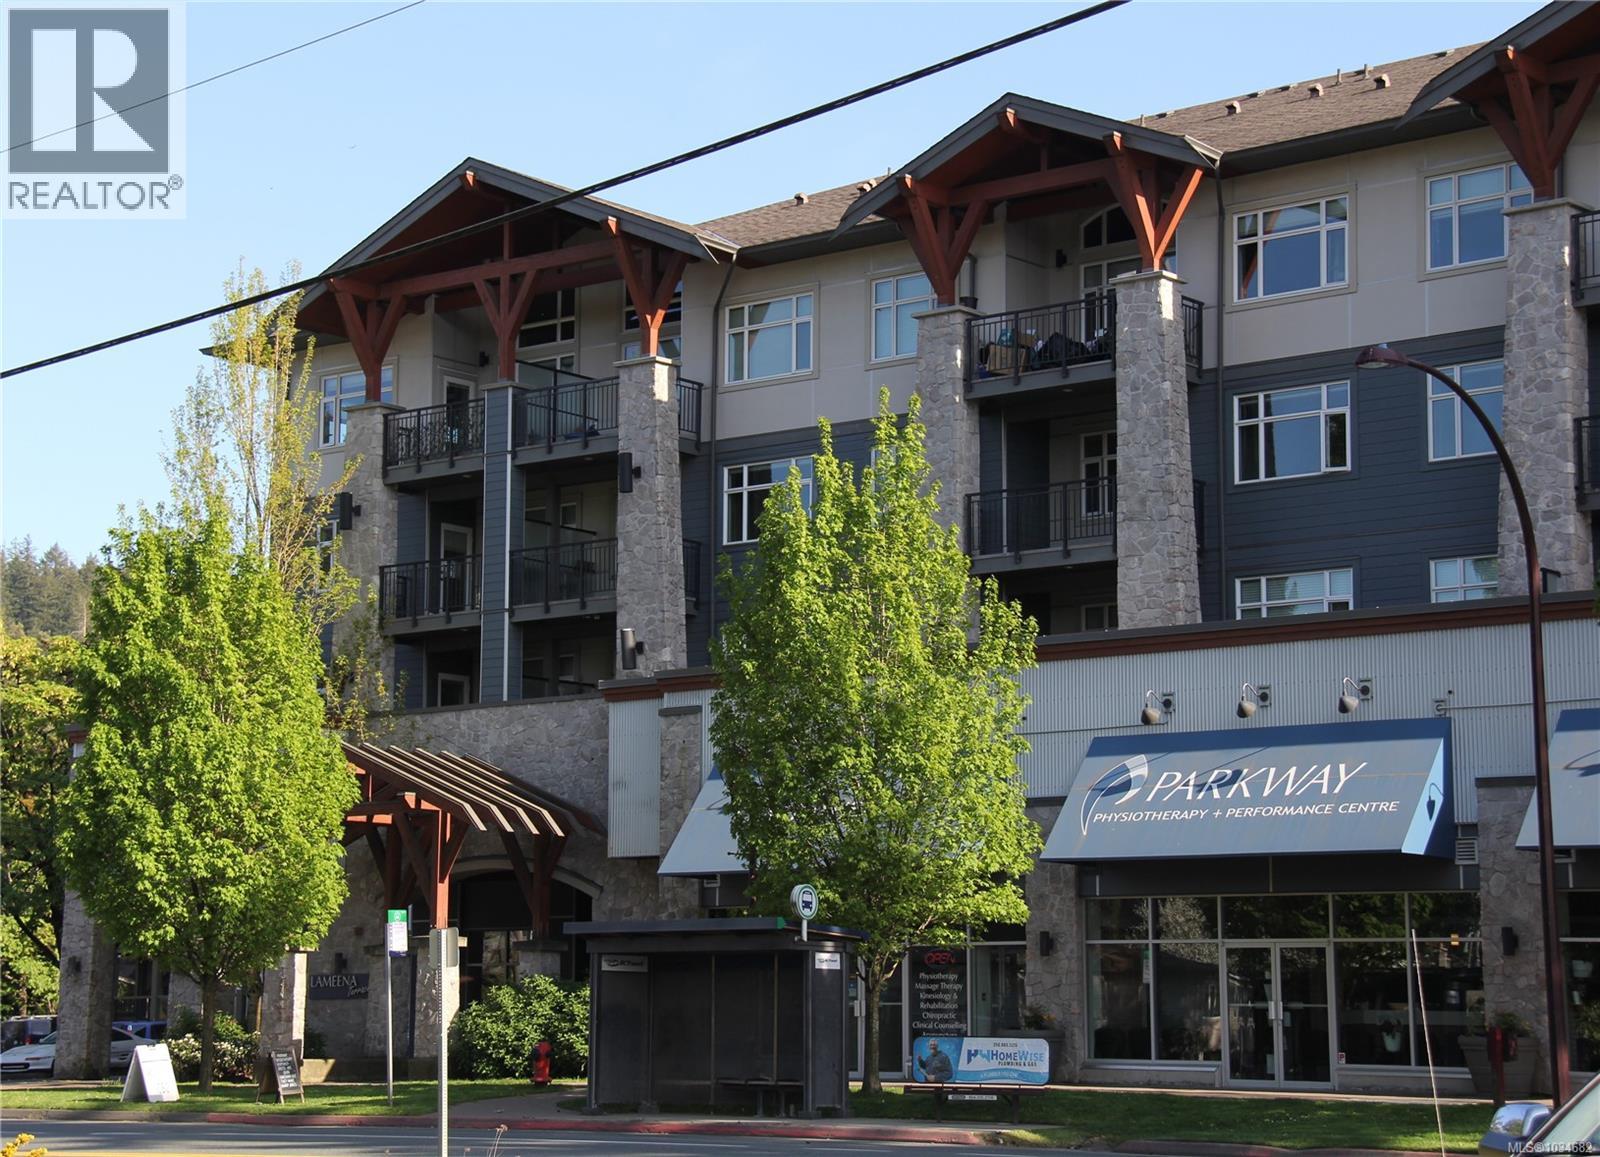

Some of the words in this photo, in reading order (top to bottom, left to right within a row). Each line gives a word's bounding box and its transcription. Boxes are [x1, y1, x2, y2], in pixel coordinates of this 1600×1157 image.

[1145, 762, 1368, 801] PARKWAY
[1093, 808, 1209, 823] PHYSIOTHERAPY
[1226, 803, 1335, 818] PERFORMANCE
[1338, 801, 1400, 814] CENTRE
[941, 982, 963, 990] Therapy
[922, 1011, 957, 1020] Chiropractic
